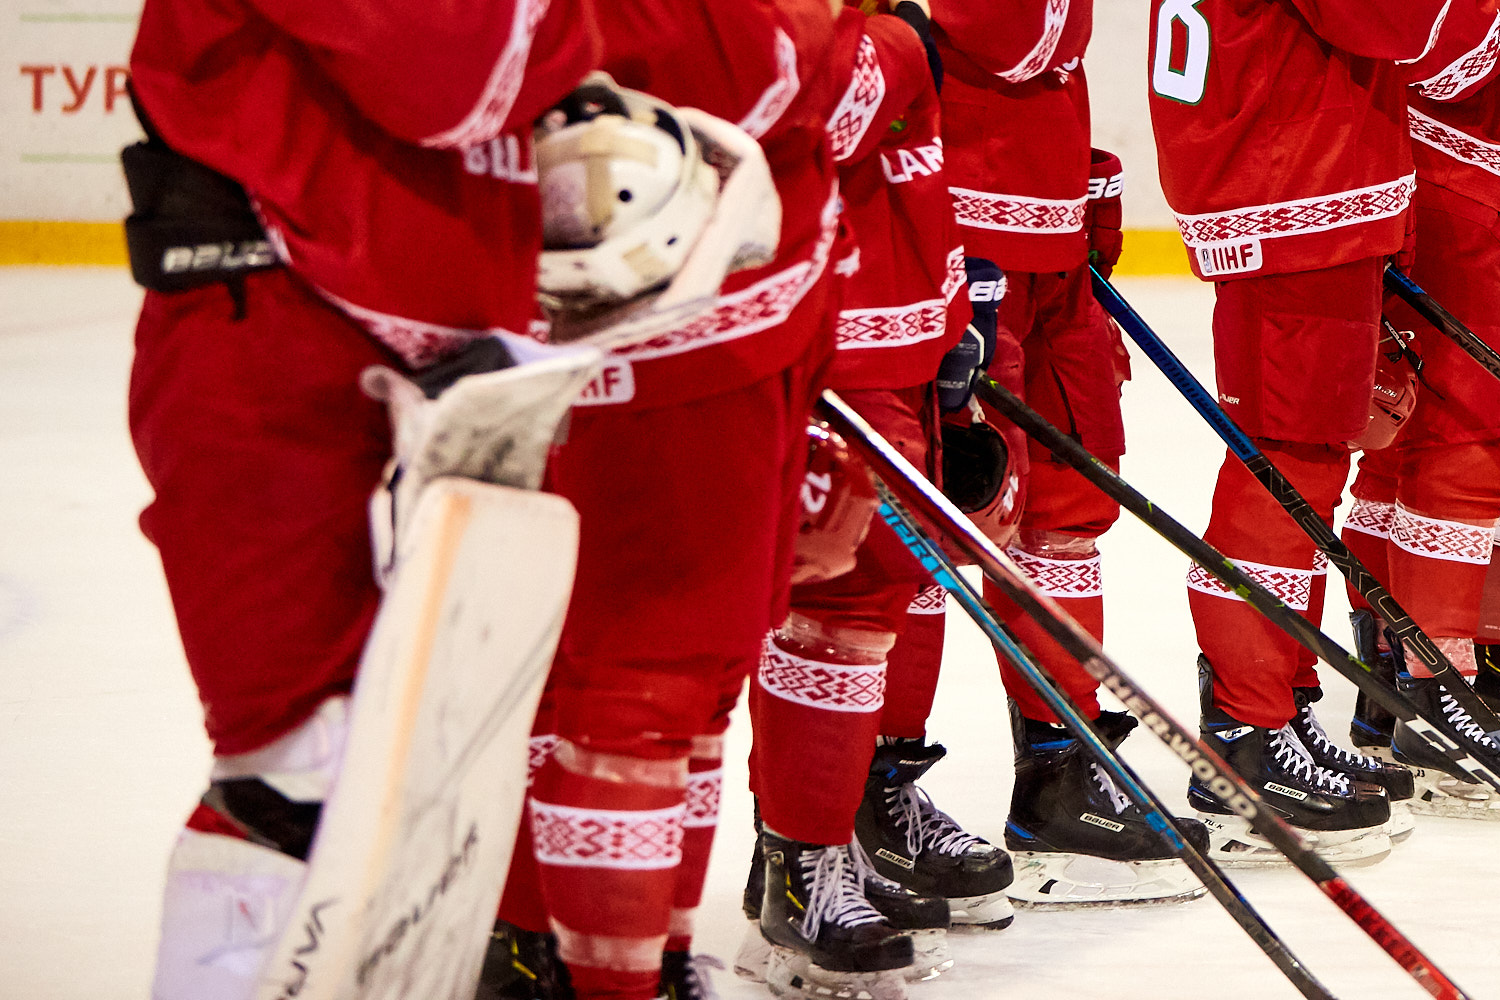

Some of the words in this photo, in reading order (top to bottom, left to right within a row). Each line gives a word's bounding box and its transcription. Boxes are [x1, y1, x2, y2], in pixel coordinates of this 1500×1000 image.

[1211, 243, 1255, 272] IIHF
[1247, 462, 1449, 676] NEXUS
[1268, 784, 1307, 799] BAUER
[1083, 814, 1122, 831] BAUER
[1204, 819, 1225, 831] TUK
[880, 850, 912, 868] BAUER
